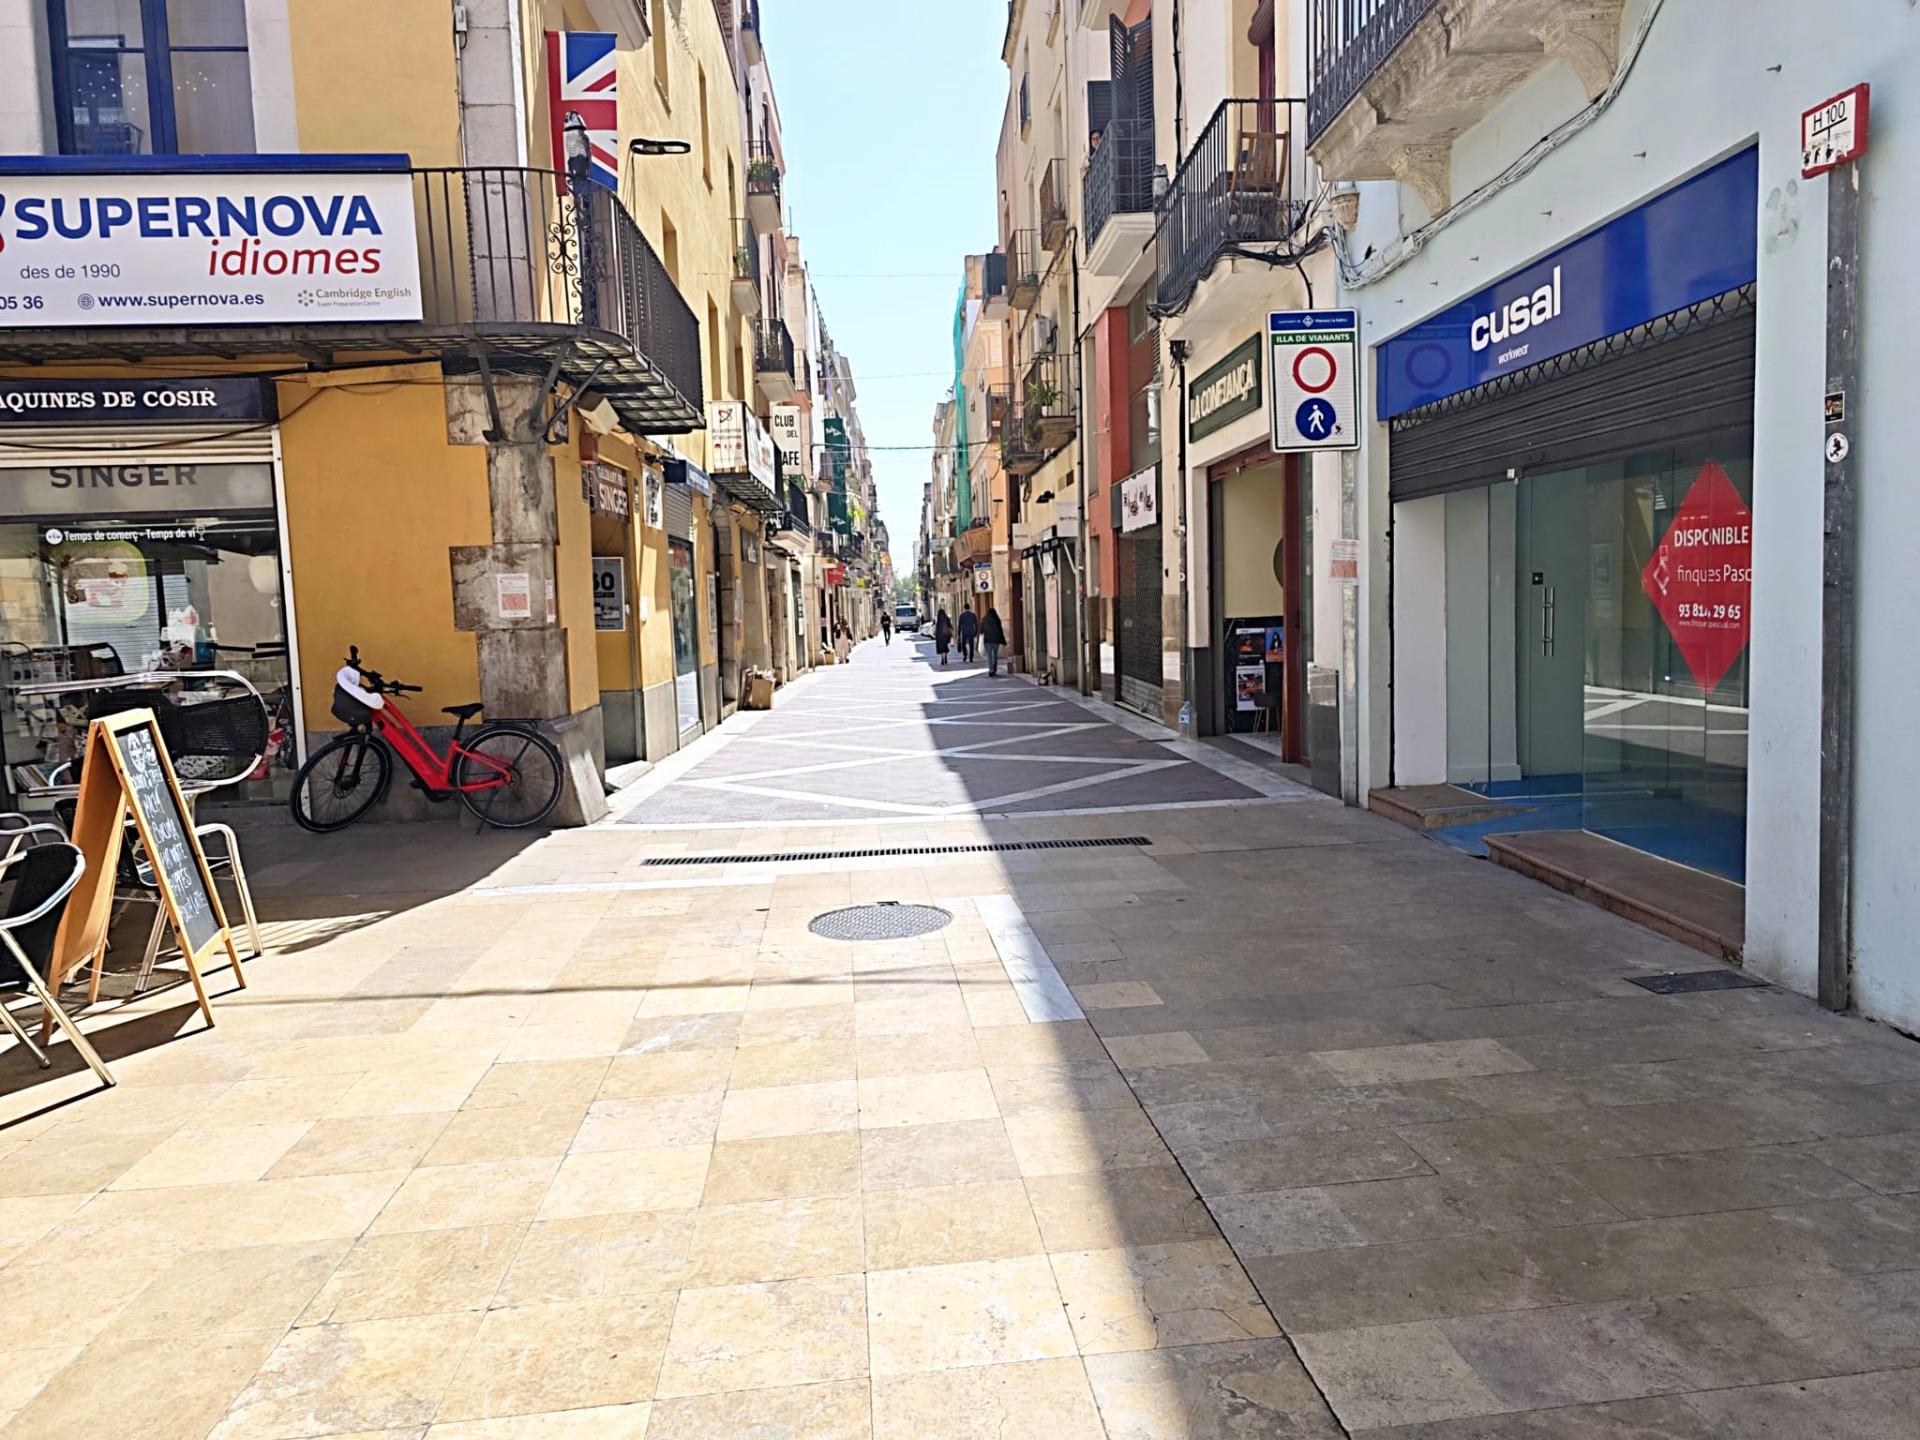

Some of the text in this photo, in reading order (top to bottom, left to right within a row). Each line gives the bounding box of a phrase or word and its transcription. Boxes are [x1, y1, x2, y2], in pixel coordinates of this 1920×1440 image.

[1813, 100, 1846, 132] H 100
[14, 194, 383, 240] SUPERNOVA
[208, 237, 382, 276] idiomes
[20, 263, 121, 279] des de 1990
[23, 295, 44, 310] 36
[98, 292, 265, 310] www.supernova.es
[315, 287, 412, 300] Cambridge English
[1470, 264, 1561, 352] cusal
[1276, 333, 1350, 343] ILLA DE VIANANTS
[1498, 343, 1530, 365] workwear
[102, 391, 136, 408] DE
[143, 390, 218, 407] COSIR
[1189, 359, 1257, 424] LA CONFIANÇA
[774, 414, 795, 427] CLUB
[786, 429, 799, 438] DEL
[781, 450, 800, 466] AFE
[49, 464, 198, 489] SINGER
[598, 483, 629, 516] SINGER
[64, 530, 93, 543] Temps
[94, 530, 105, 541] de
[106, 530, 138, 542] comerç
[145, 528, 174, 541] Temps
[176, 528, 186, 538] de
[1674, 525, 1750, 548] DISPONIBLE
[1677, 564, 1721, 587] finques
[1678, 603, 1691, 618] 93
[1713, 604, 1726, 619] 29
[1728, 604, 1741, 620] 65
